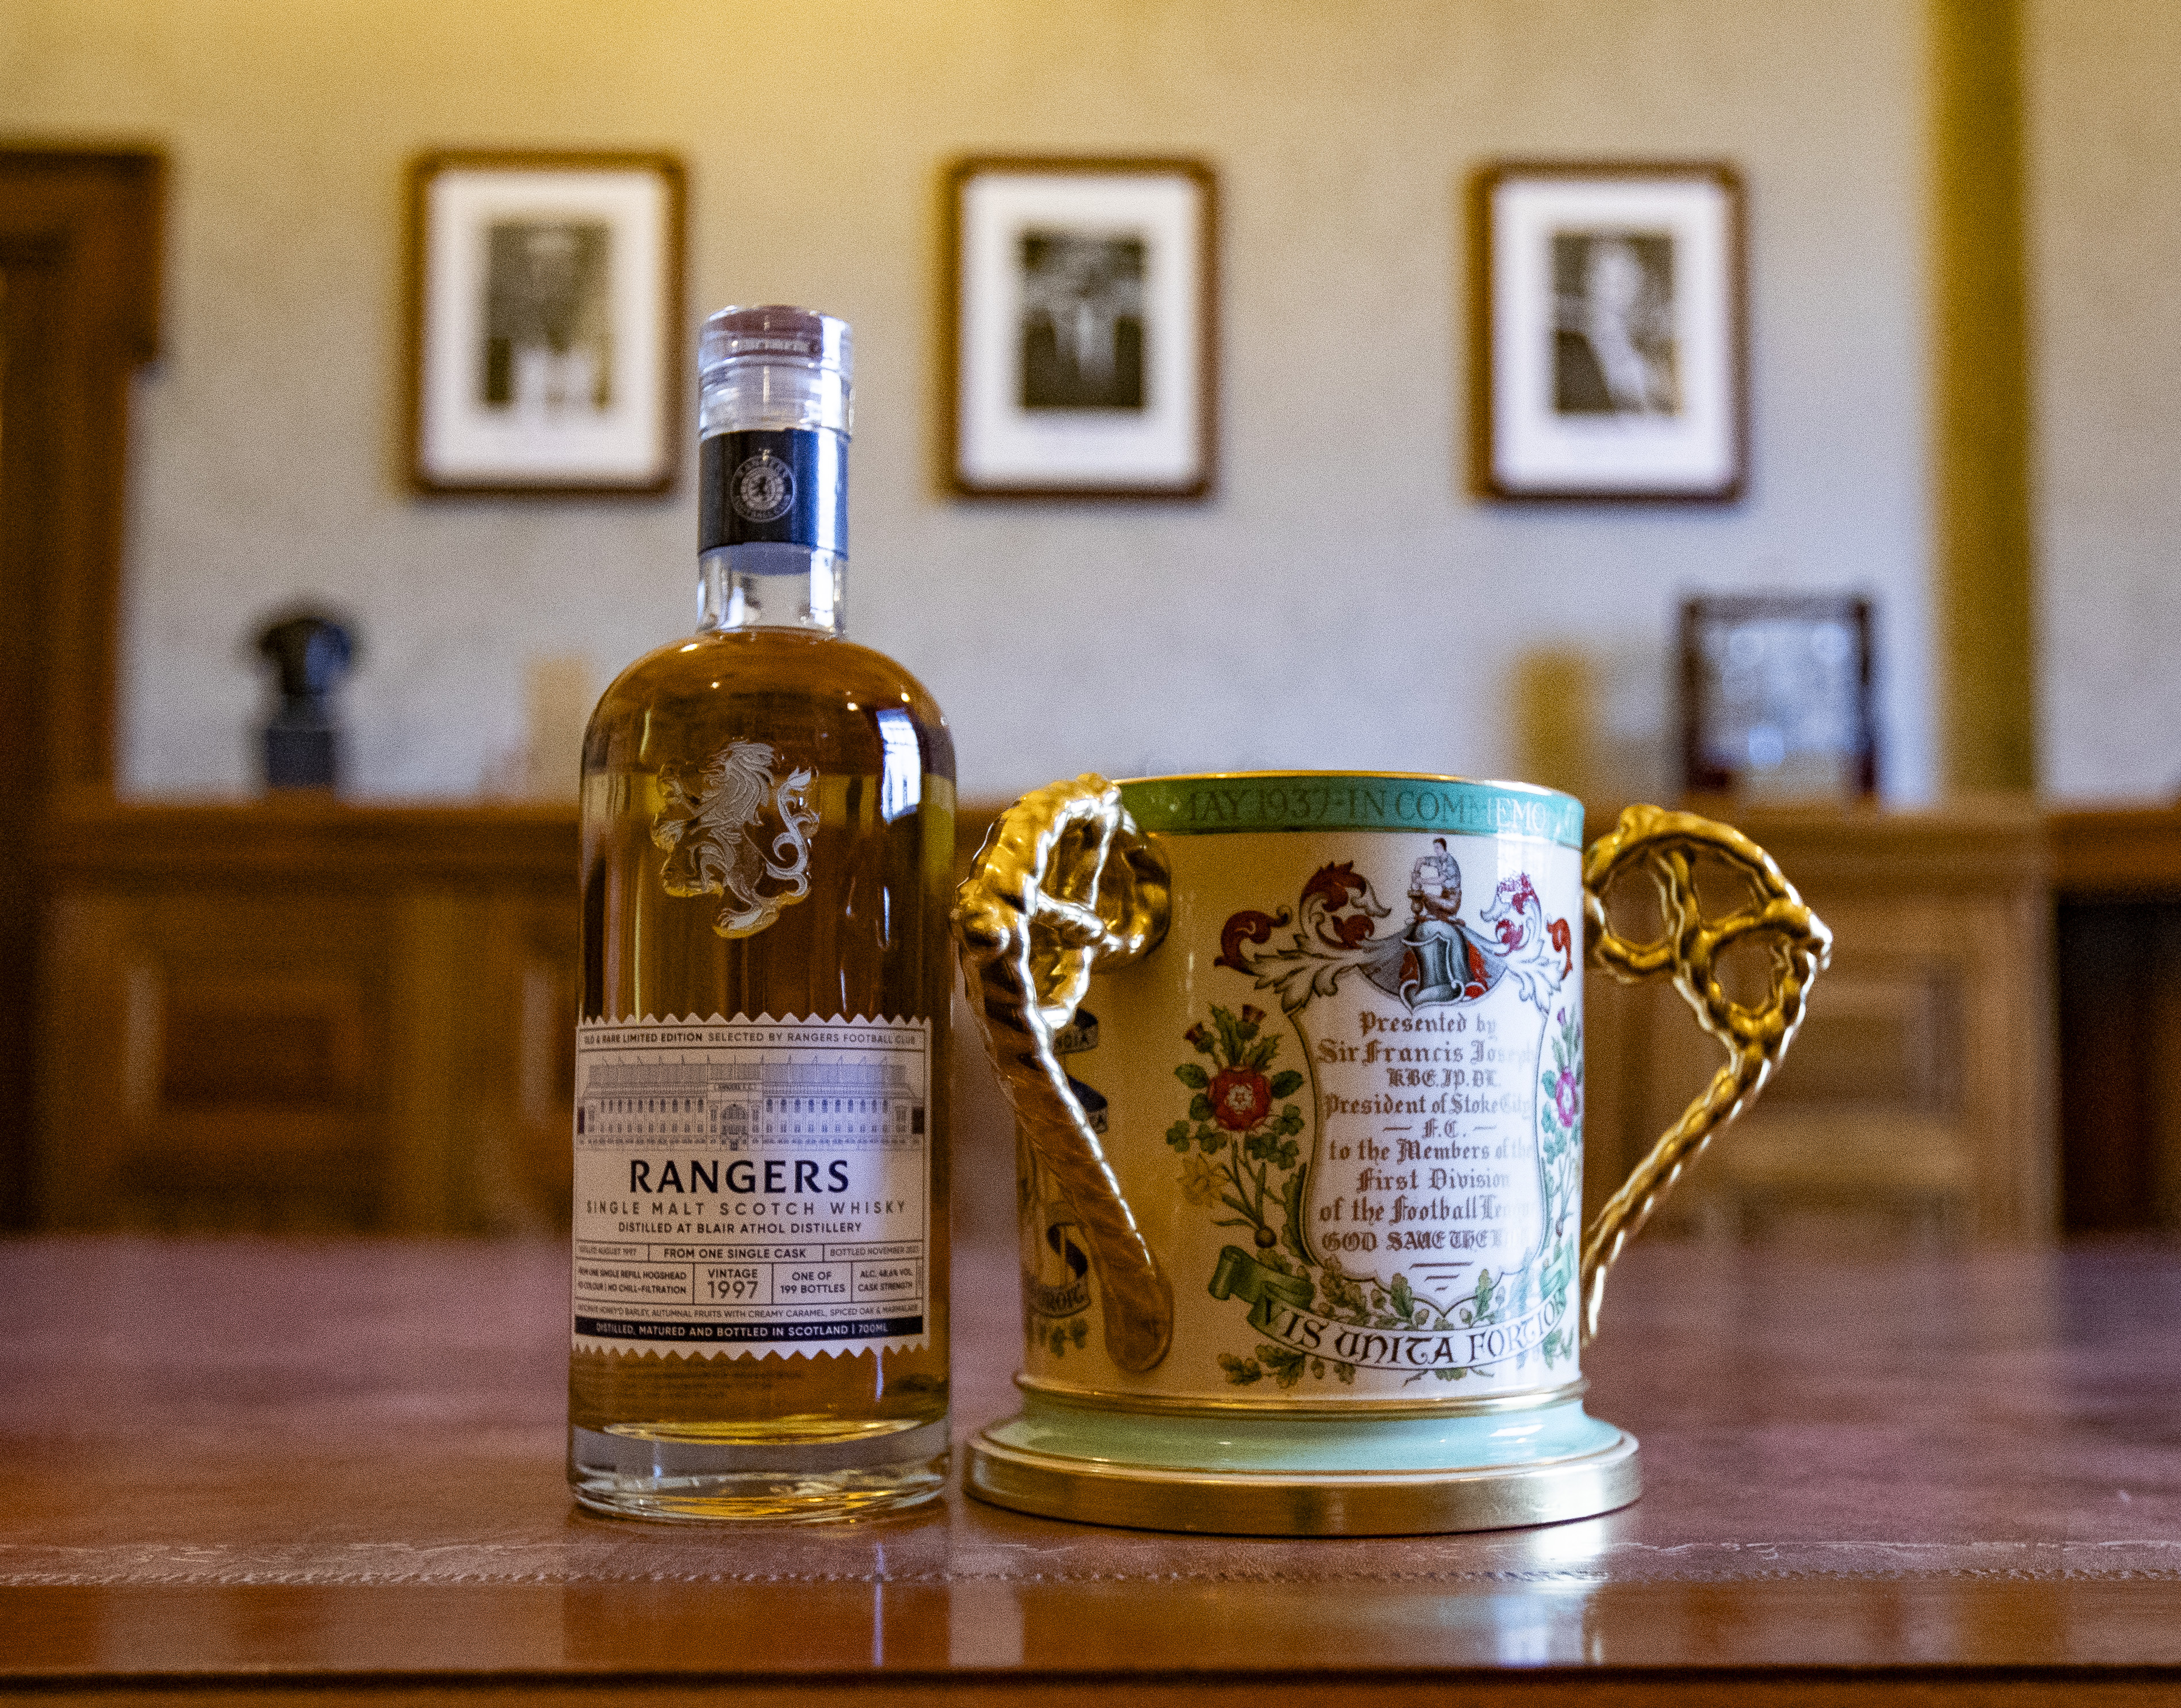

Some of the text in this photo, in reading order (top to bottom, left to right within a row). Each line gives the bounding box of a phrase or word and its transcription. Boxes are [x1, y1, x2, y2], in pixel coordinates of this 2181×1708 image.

[1359, 1010, 1498, 1041] Presented by
[622, 1033, 658, 1043] LIMITED
[660, 1032, 703, 1043] EDITION
[707, 1032, 764, 1042] SELECTED
[768, 1032, 783, 1042] BY
[787, 1032, 840, 1043] RANGERS
[843, 1032, 893, 1045] FOOTBALL
[894, 1034, 916, 1045] CLUB
[1317, 1038, 1360, 1063] Sir
[1361, 1038, 1464, 1067] Francis
[1325, 1092, 1426, 1120] President
[1431, 1092, 1449, 1114] of
[1449, 1092, 1498, 1115] Stoke
[1328, 1139, 1351, 1161] to
[1357, 1137, 1391, 1166] the
[1395, 1138, 1490, 1165] Members
[1494, 1136, 1510, 1160] of
[630, 1159, 849, 1194] RANGERS
[1355, 1167, 1510, 1194] First Division
[586, 1201, 905, 1216] SINGLE MALT SCOTCH WHISKY
[1317, 1196, 1346, 1222] of
[1351, 1195, 1385, 1226] the
[1388, 1194, 1478, 1226] Football
[618, 1222, 862, 1234] DISTILLED AT BLAIR ATHOL DISTILLERY
[1322, 1230, 1378, 1252] GOD
[663, 1248, 807, 1260] FROM ONE SINGLE CASK
[830, 1247, 866, 1257] BOTTLED
[867, 1245, 905, 1256] NOVEMBER
[621, 1270, 641, 1279] REFILL
[643, 1271, 687, 1280] HOGSHEAD
[707, 1268, 758, 1279] VINTAGE
[791, 1271, 832, 1281] ONE OF
[607, 1283, 617, 1292] NO
[706, 1280, 759, 1299] 1997
[780, 1283, 845, 1294] 199 BOTTLES
[857, 1280, 913, 1292] CASK STRENGTH
[651, 1309, 693, 1318] AUTUMNAL
[694, 1309, 722, 1319] FRUITS
[724, 1309, 747, 1319] WITH
[748, 1309, 784, 1319] CREAMY
[830, 1307, 858, 1317] SPICED
[859, 1306, 874, 1315] OAK
[638, 1325, 686, 1337] MATURED
[689, 1326, 713, 1337] AND
[716, 1326, 768, 1337] BOTTLED
[772, 1326, 784, 1337] IN
[788, 1325, 849, 1337] SCOTLAND
[858, 1323, 888, 1333] 700ML
[1334, 1325, 1457, 1365] UNITA
